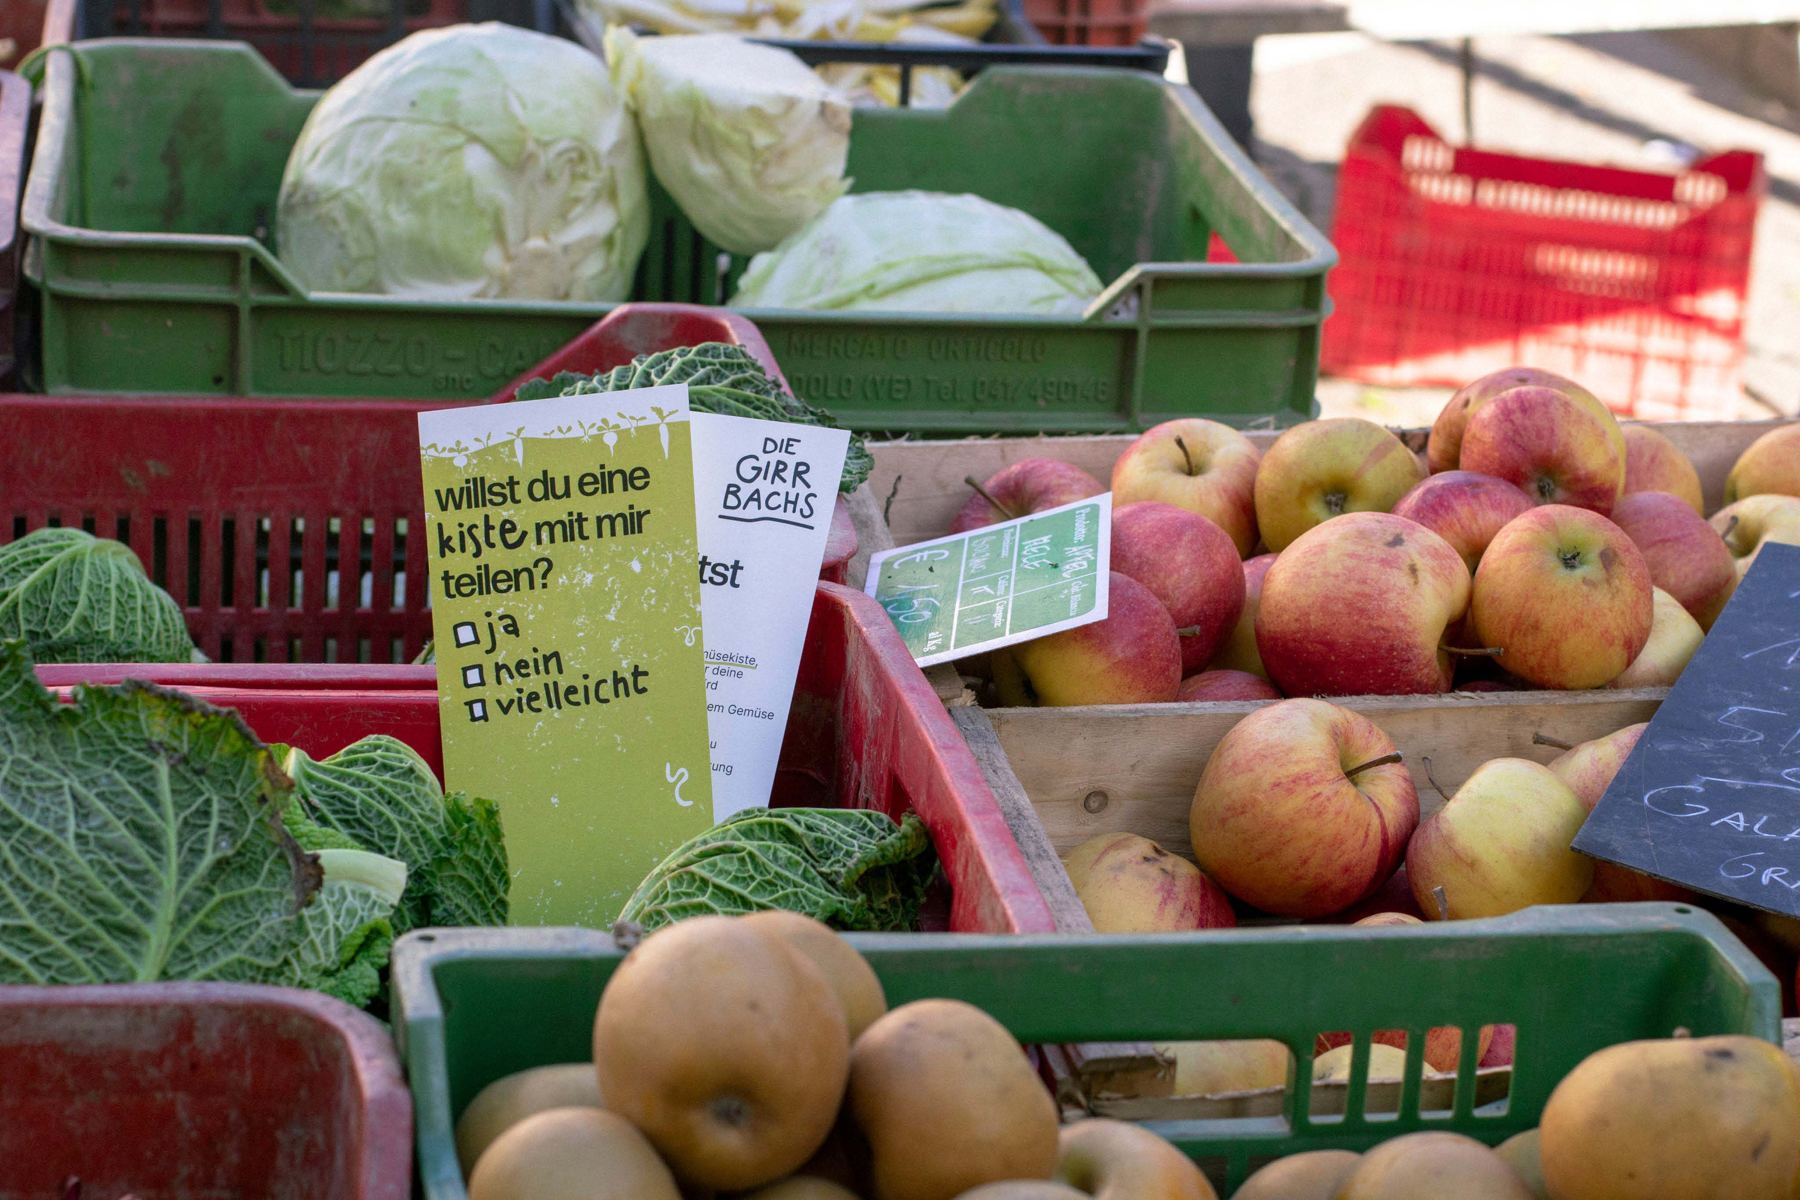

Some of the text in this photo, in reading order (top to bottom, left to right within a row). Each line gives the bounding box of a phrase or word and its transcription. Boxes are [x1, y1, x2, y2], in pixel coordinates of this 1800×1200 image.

[787, 332, 1048, 364] MERCATO ORTICOLO
[762, 437, 801, 455] DIE
[434, 463, 650, 512] willst du eine
[736, 454, 811, 489] GIRR
[722, 483, 818, 519] BACHS
[437, 504, 651, 559] kiste mit mir
[441, 557, 554, 599] teilen?
[698, 552, 744, 588] tst
[484, 611, 520, 654] ja
[494, 647, 564, 685] nein
[712, 666, 744, 679] deine
[496, 664, 649, 716] vielleicht
[728, 704, 775, 720] Gemüse
